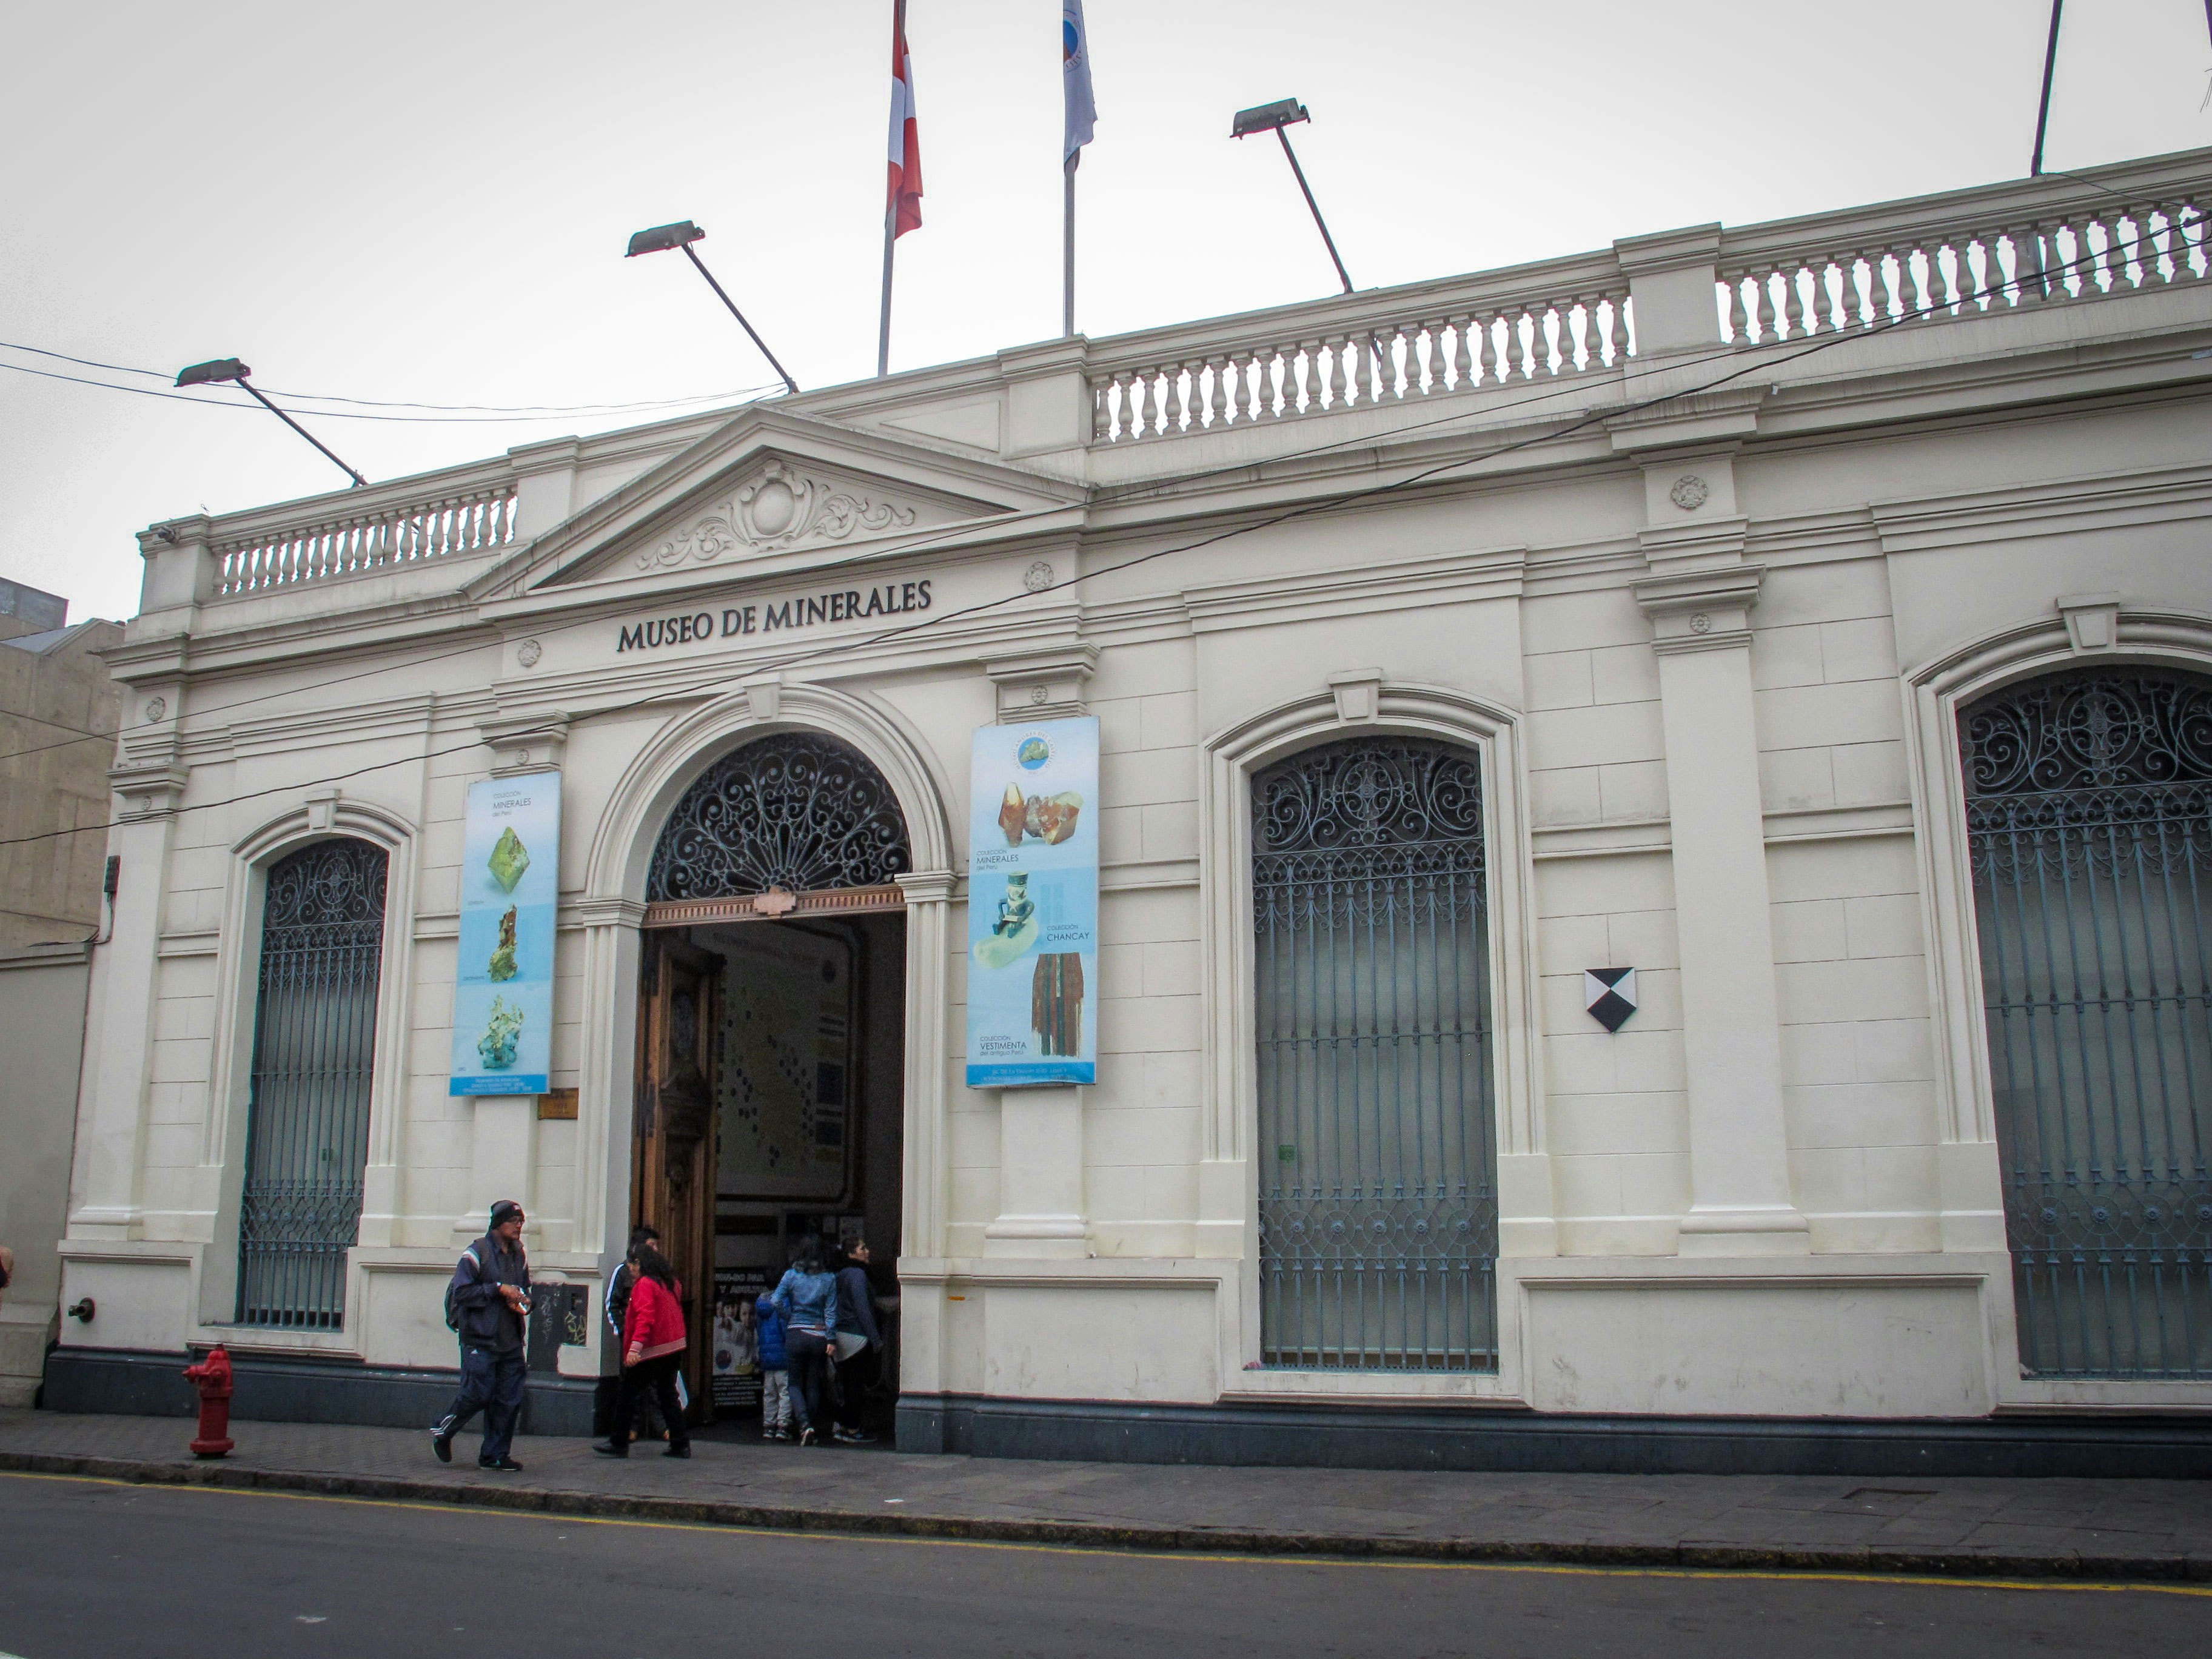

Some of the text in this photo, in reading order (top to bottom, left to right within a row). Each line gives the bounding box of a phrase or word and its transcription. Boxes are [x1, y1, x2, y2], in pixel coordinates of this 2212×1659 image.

[617, 579, 933, 653] MUSEO DE MINERALES
[494, 798, 532, 809] MINERALES
[977, 855, 1019, 863] MINERALES
[1047, 932, 1090, 941] CHANCAY
[980, 1041, 1027, 1050] VESTIMENTA
